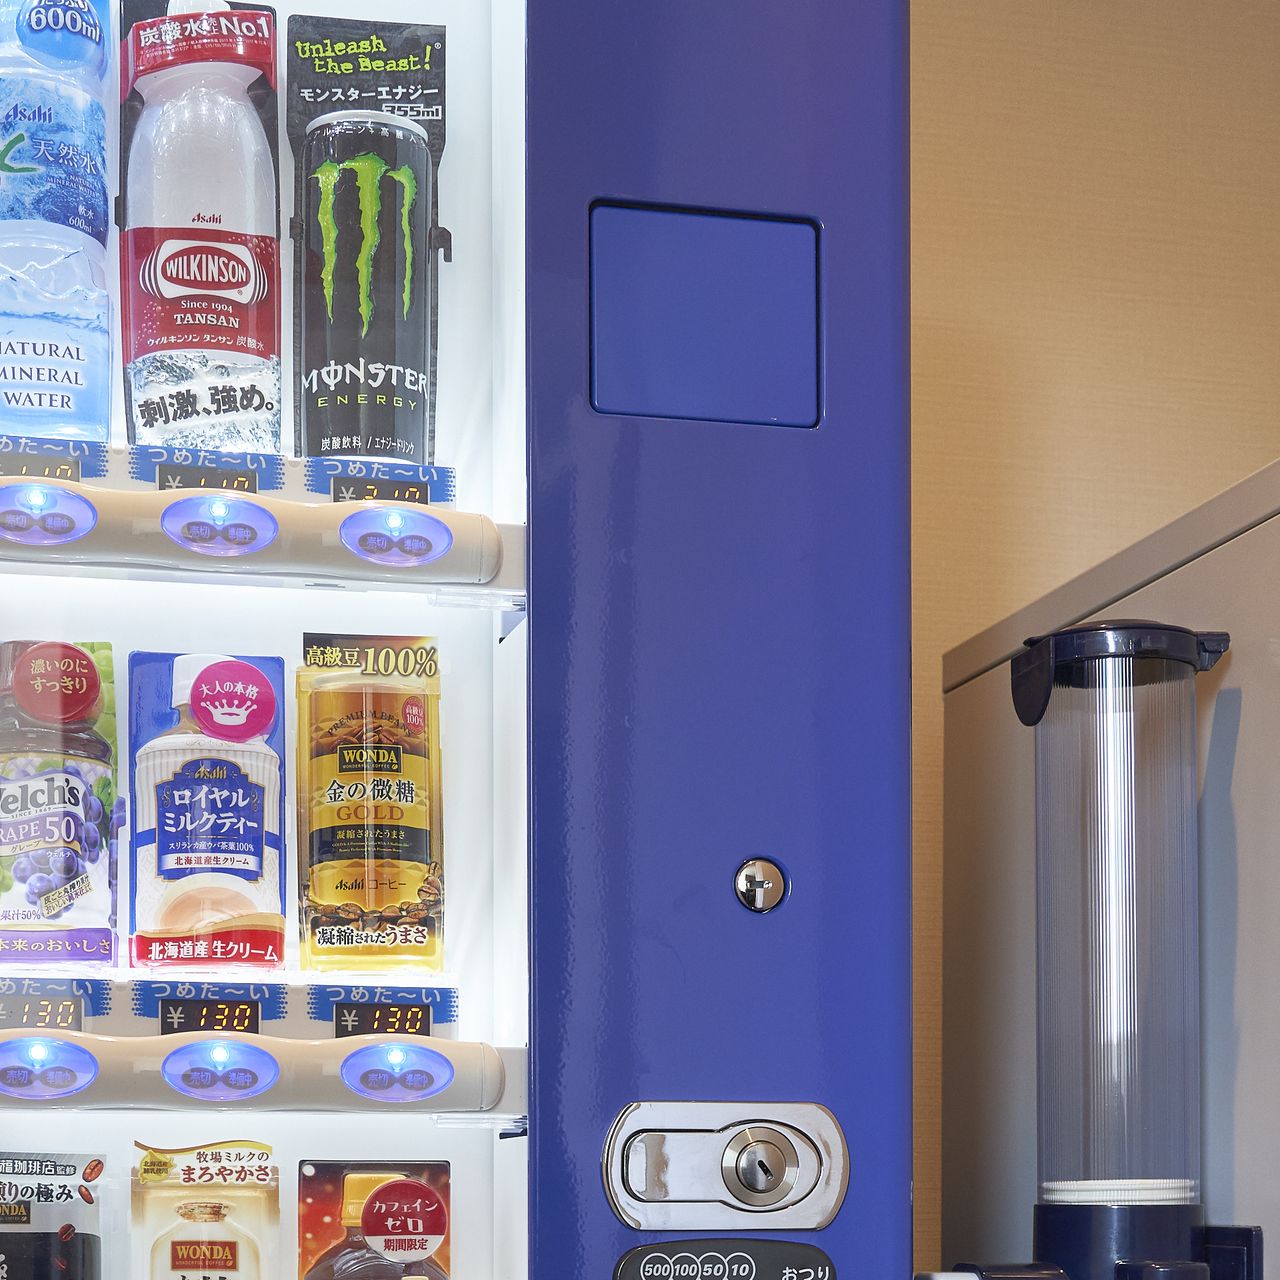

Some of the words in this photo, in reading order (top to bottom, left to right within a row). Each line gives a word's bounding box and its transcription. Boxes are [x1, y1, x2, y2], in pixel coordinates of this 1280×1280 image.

[30, 8, 100, 43] 600ml
[220, 16, 269, 38] No.1
[295, 34, 387, 58] Unleash
[314, 58, 353, 74] the
[358, 45, 432, 72] Beast!
[300, 85, 439, 102] モンスターエナジー
[5, 103, 53, 124] Asahi
[381, 104, 442, 119] 355ml
[32, 138, 97, 175] 天然水
[191, 212, 222, 225] Asahi
[166, 254, 247, 283] WILKINSON
[181, 300, 208, 309] Since
[211, 302, 233, 313] 1904
[173, 314, 240, 329] TANSAN
[147, 334, 200, 347] ウィルキンソン
[203, 334, 233, 344] タンサン
[236, 336, 265, 351] 炭酸水
[302, 357, 428, 399] MONSTER
[3, 391, 72, 409] WATER
[138, 384, 274, 429] 刺激、強め。
[317, 394, 417, 410] ENERGY
[321, 435, 362, 451] 炭酸飲料
[374, 436, 415, 455] エナジードリンク
[30, 657, 88, 675] 濃いのに
[306, 645, 437, 677] 高級豆100%
[30, 676, 88, 694] すっきり
[199, 679, 261, 700] 大人の本格
[342, 748, 398, 764] WONDA
[194, 763, 228, 781] Asahi
[173, 788, 251, 808] ロイヤル
[326, 779, 416, 804] 金の微糖
[336, 804, 405, 821] GOLD
[44, 815, 76, 843] 50
[164, 812, 259, 834] ミルクティー
[336, 829, 406, 841] 凝縮されたうまさ
[174, 853, 251, 866] 北海道産生クリーム
[317, 925, 428, 946] 凝縮されたうまさ
[148, 940, 209, 961] 北海道産
[212, 940, 278, 962] 生クリーム
[196, 1151, 269, 1164] 牧場ミルクの
[181, 1164, 271, 1184] まろやかさ
[372, 1198, 438, 1213] カフェイン
[384, 1216, 424, 1233] ゼロ
[176, 1245, 233, 1260] WONDA
[383, 1238, 428, 1252] 期間限定
[644, 1263, 670, 1278] 500
[673, 1263, 699, 1278] 100
[701, 1263, 725, 1278] 50
[730, 1263, 750, 1278] 10
